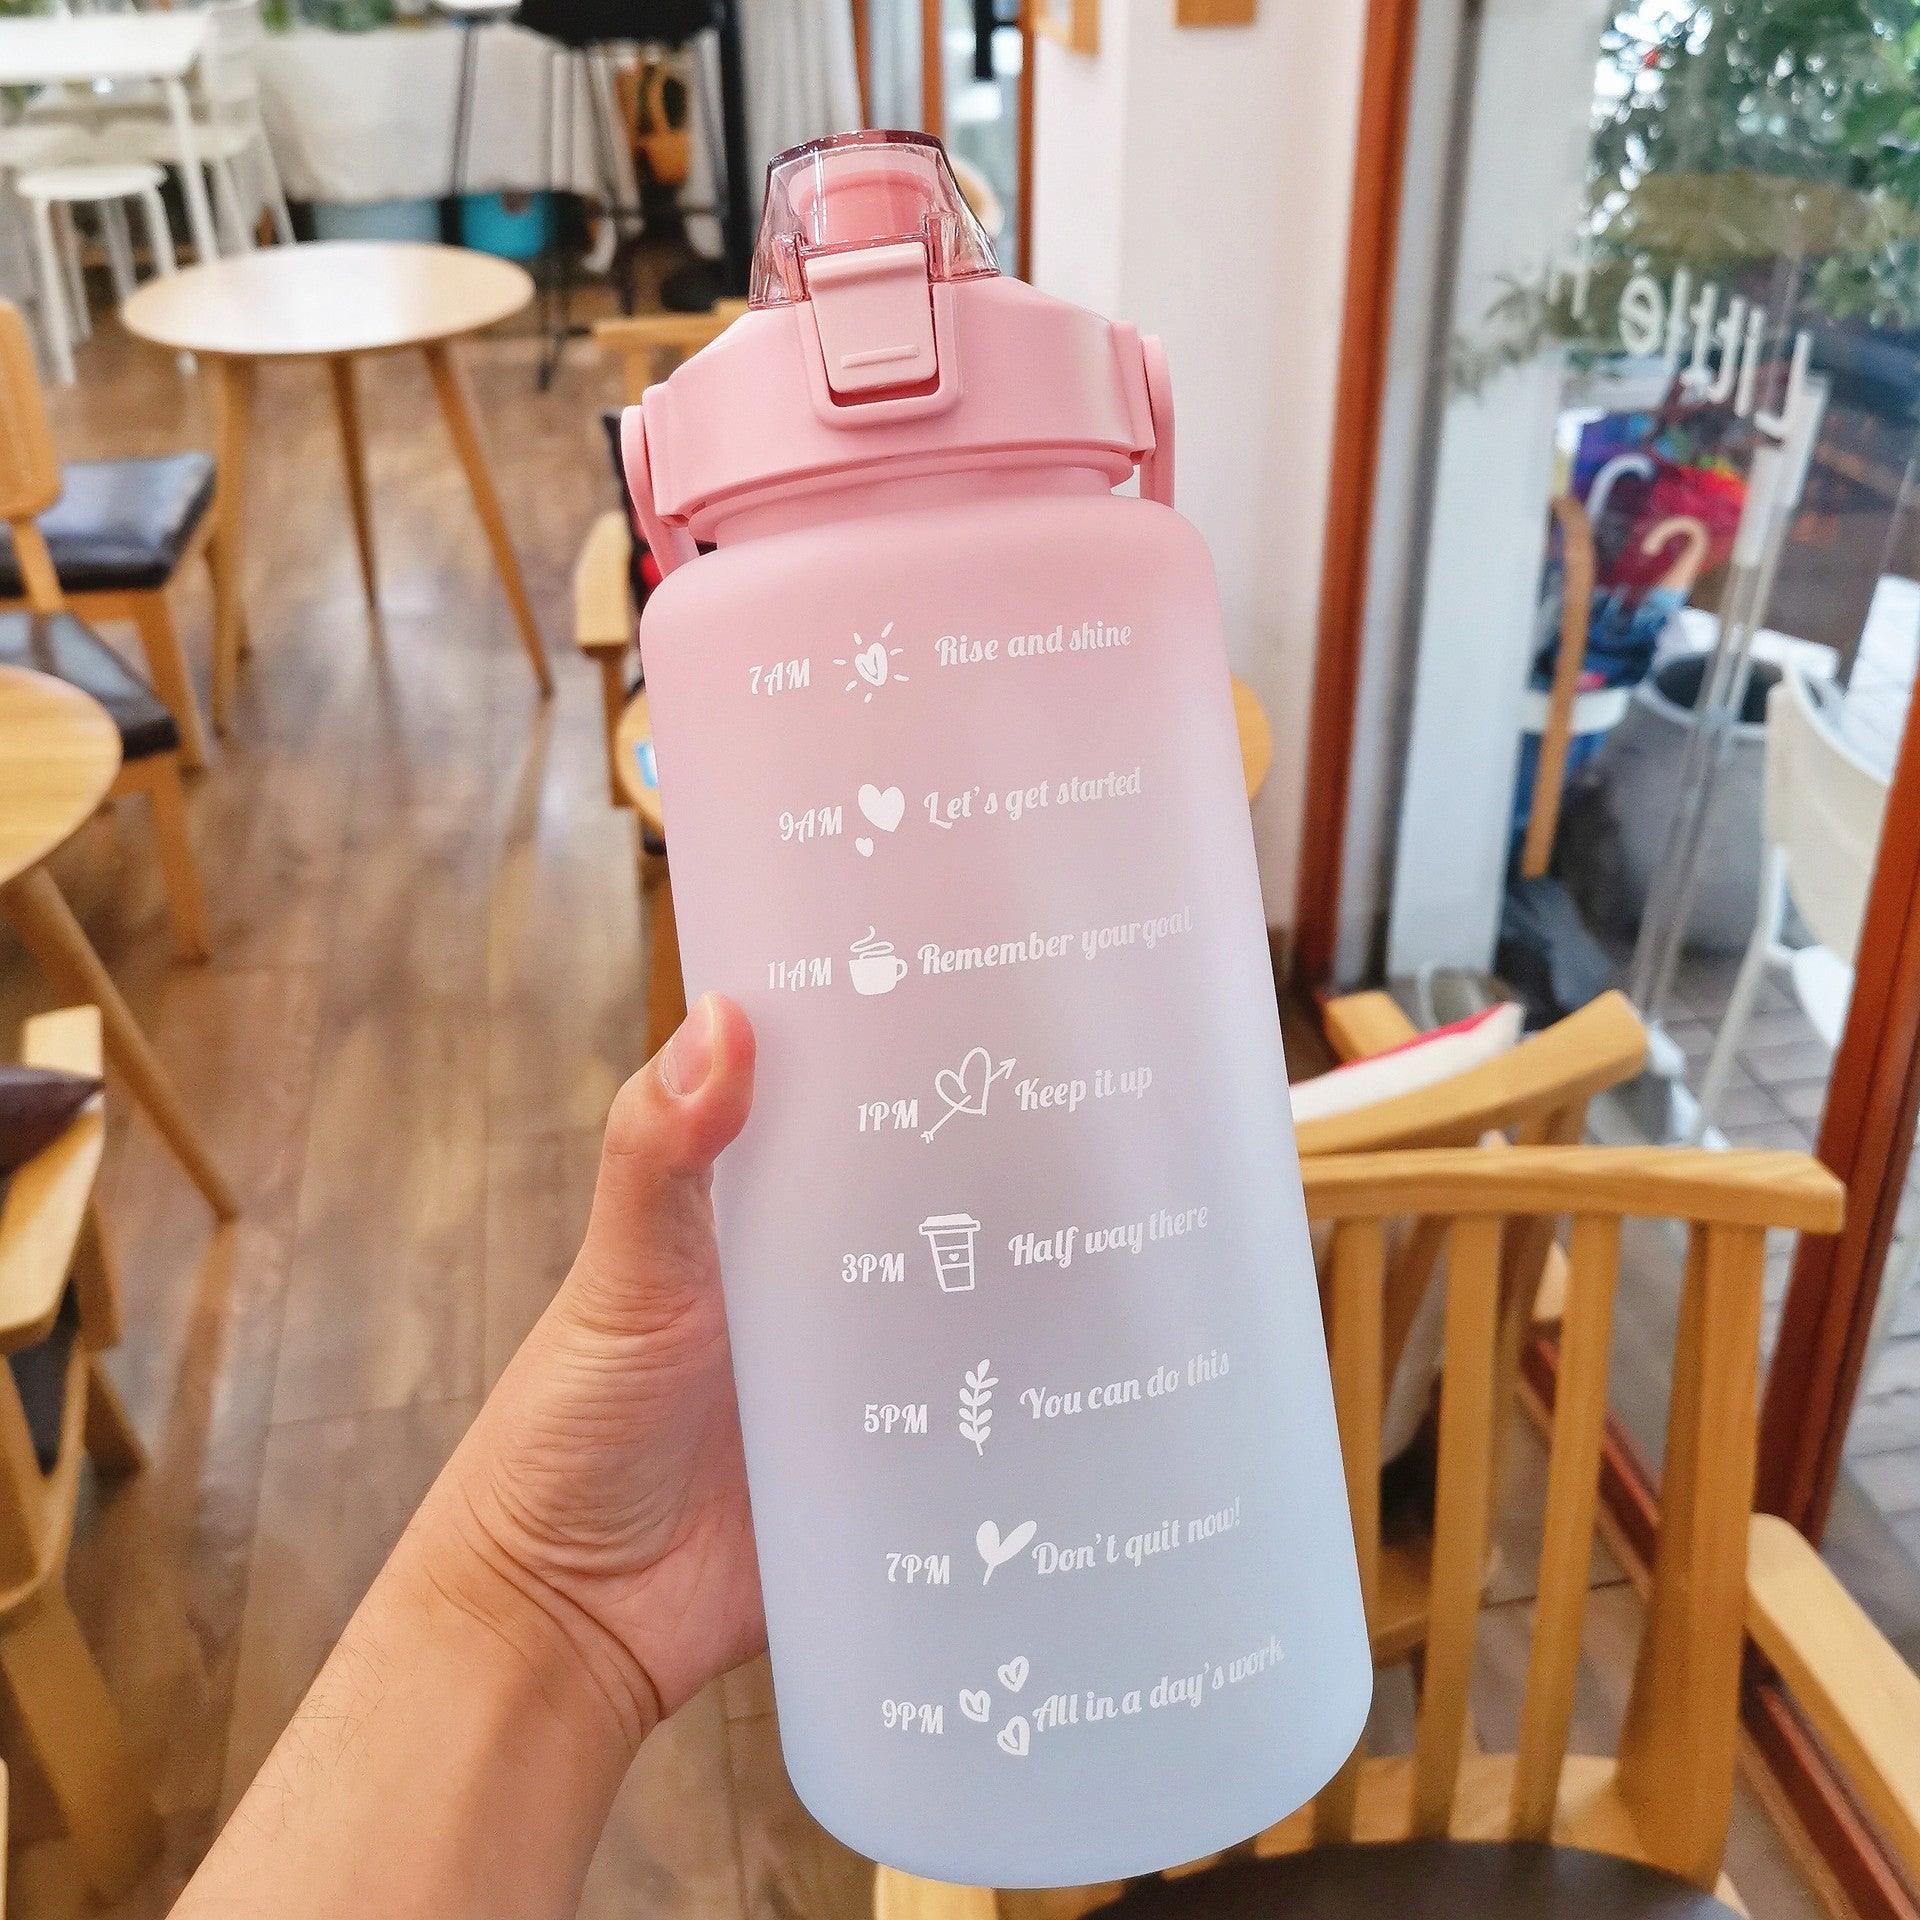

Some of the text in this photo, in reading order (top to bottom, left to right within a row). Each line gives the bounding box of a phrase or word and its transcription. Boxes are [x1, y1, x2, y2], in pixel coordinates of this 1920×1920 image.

[749, 619, 1133, 695] 7AM Rise and shine
[778, 767, 1142, 843] 9AM Let's get started
[767, 957, 832, 992] 11AM
[917, 931, 1074, 976] Remember
[857, 1064, 1153, 1131] 1PM Keep it up
[841, 1206, 1209, 1283] 3PM Half way there
[864, 1349, 1231, 1434] 5PM You can do this
[885, 1496, 1241, 1584] 7PM Don't quit now!
[881, 1635, 1286, 1735] 9PM All in a day's work
